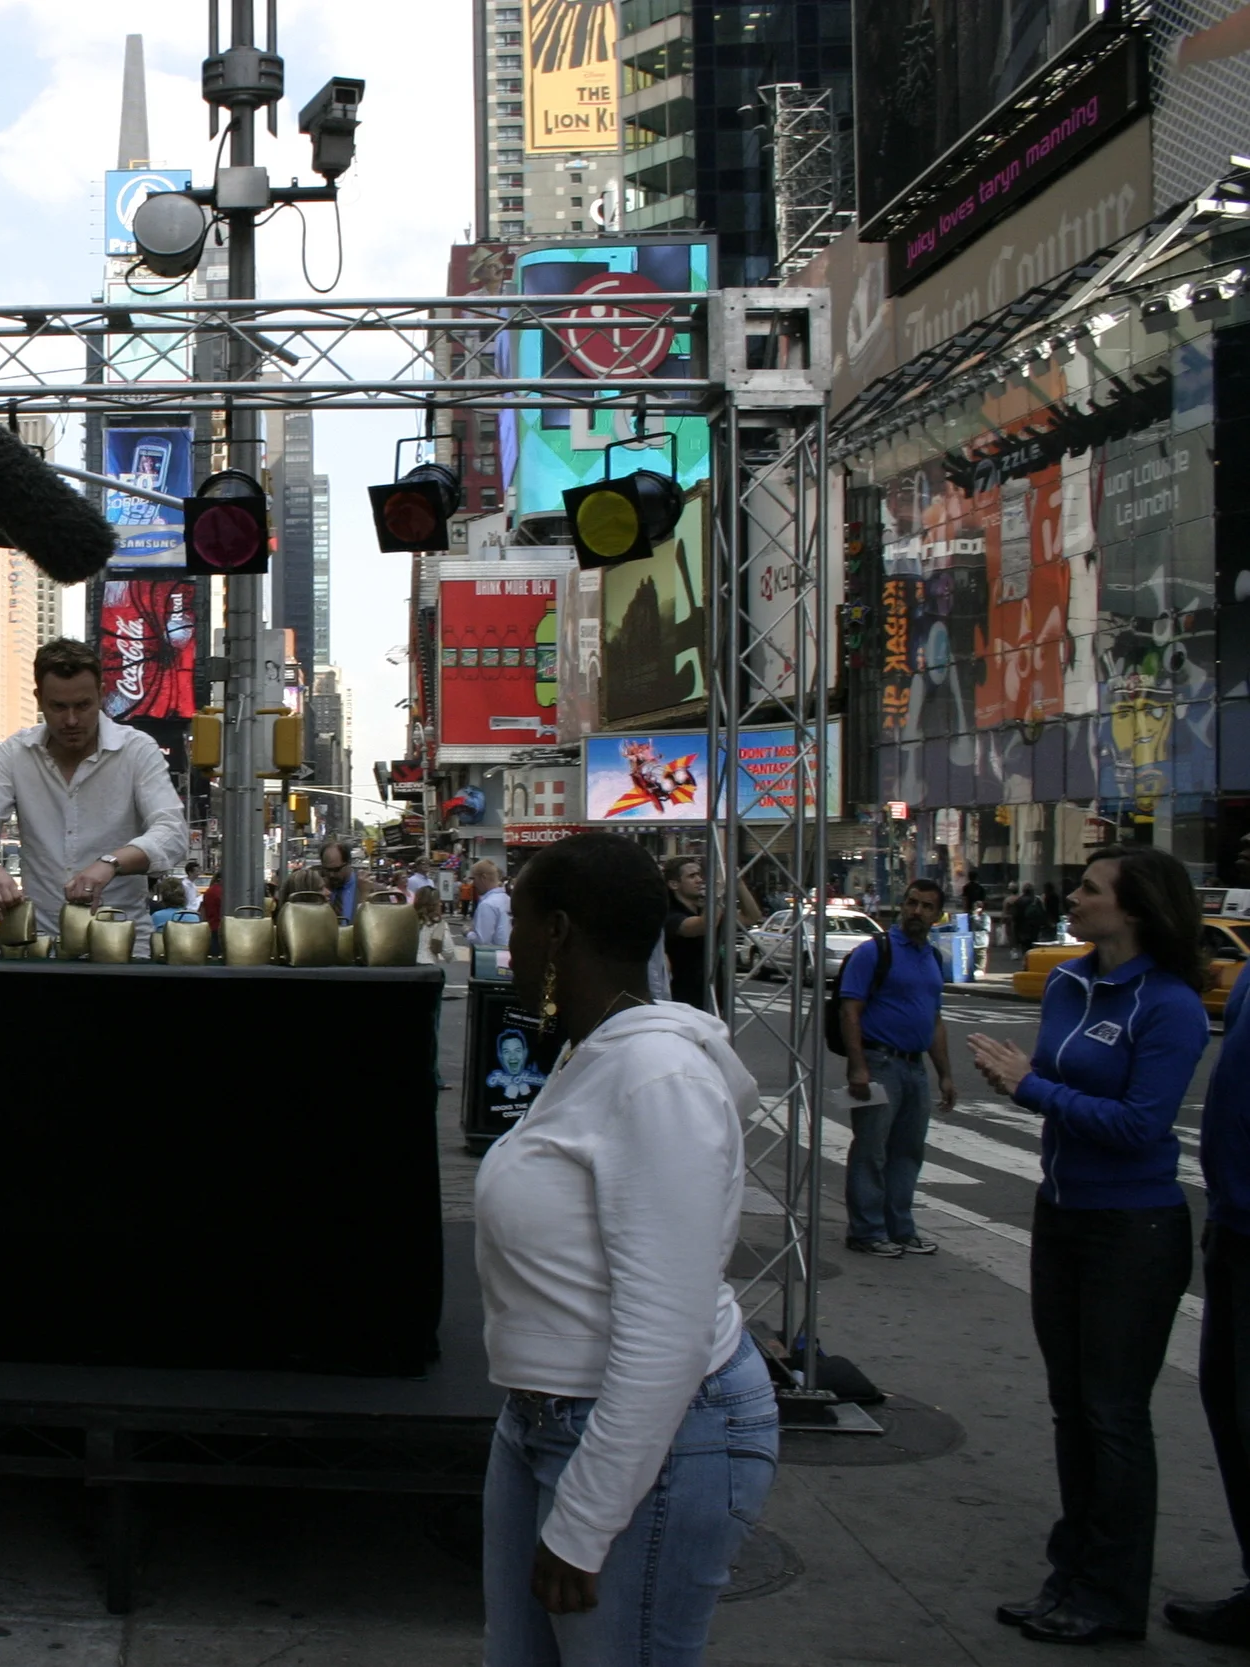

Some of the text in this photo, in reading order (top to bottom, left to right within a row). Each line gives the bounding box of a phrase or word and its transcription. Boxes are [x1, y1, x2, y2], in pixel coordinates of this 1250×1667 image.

[577, 86, 611, 101] THE
[544, 109, 590, 135] LION
[906, 95, 1100, 269] juicy loves taryn manning
[119, 539, 178, 549] SAMSUNG
[505, 580, 529, 596] MORE
[170, 593, 183, 621] Real
[521, 828, 572, 843] swatch
